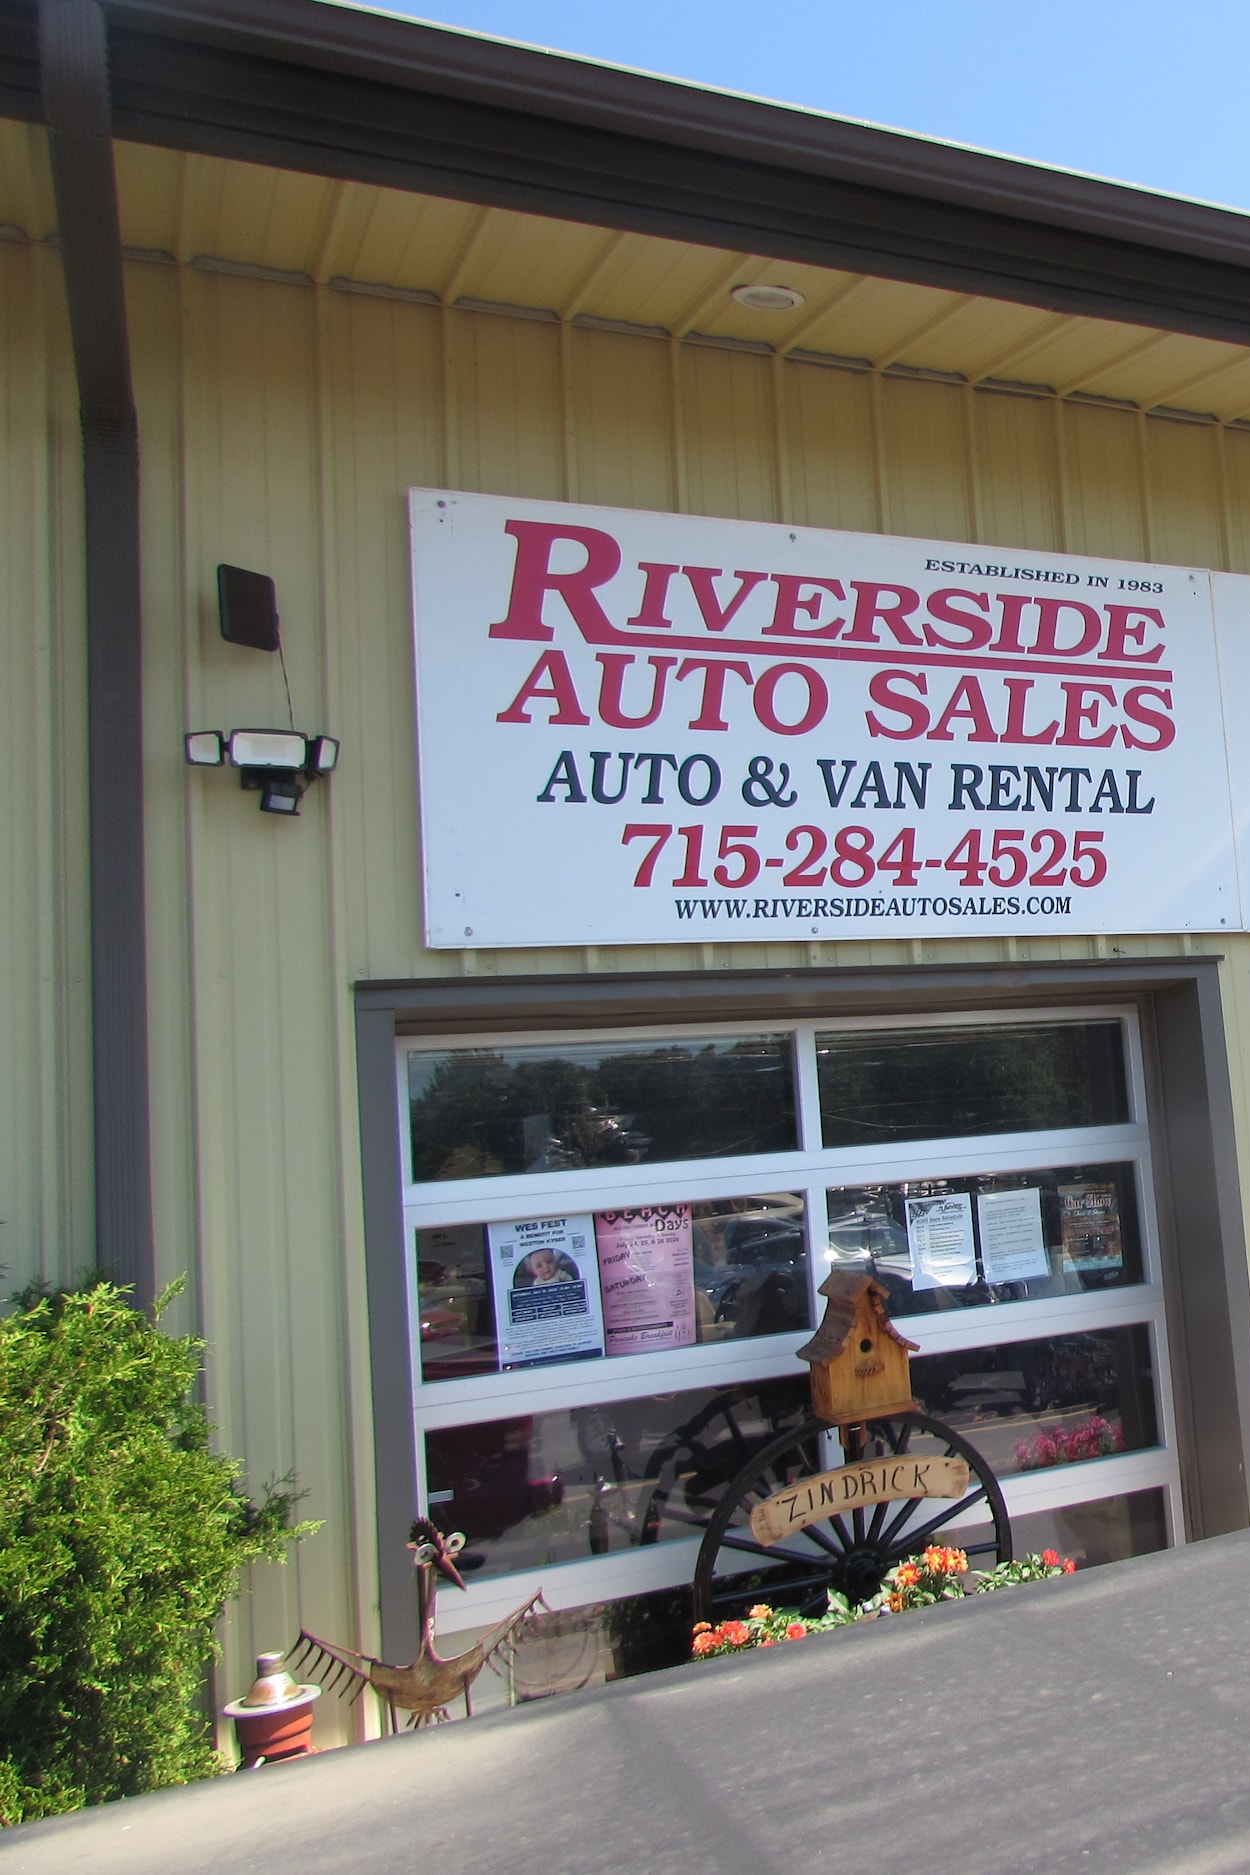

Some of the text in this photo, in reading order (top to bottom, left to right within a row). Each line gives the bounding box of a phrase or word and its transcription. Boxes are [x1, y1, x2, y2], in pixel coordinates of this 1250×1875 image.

[925, 559, 1164, 594] ESTABLISHED IN 1983
[488, 518, 1168, 665] RIVERSIDE
[496, 649, 1177, 752] AUTO SALES
[536, 750, 1155, 815] AUTO & VAN RENTAL
[621, 823, 1108, 889] 715-284-4525
[674, 896, 1073, 920] WWW.RIVERSIDEAUTOSALES.COM
[1064, 1193, 1112, 1210] Car Show
[514, 1218, 567, 1232] WES FEST
[655, 1218, 689, 1232] Days
[603, 1250, 631, 1266] FRIDAY
[604, 1273, 646, 1294] SATURDAY
[640, 1329, 674, 1341] Breakfast
[776, 1464, 930, 1523] ZINDRICK
